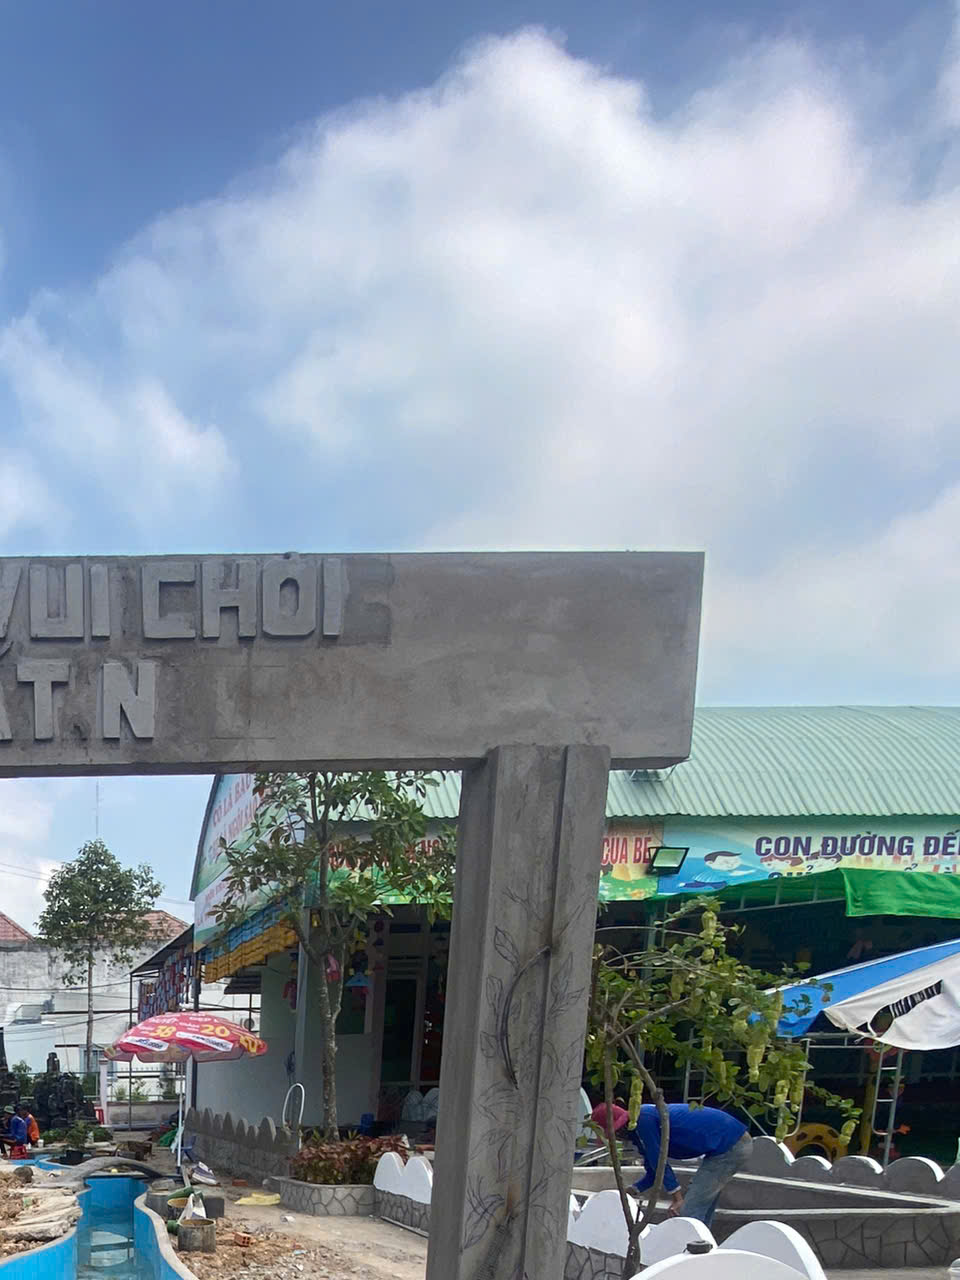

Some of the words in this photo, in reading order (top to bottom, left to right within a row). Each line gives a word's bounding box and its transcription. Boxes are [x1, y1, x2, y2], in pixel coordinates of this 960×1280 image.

[755, 835, 812, 857] CON
[820, 831, 915, 857] ĐƯỜNG
[923, 829, 960, 857] ĐẾ
